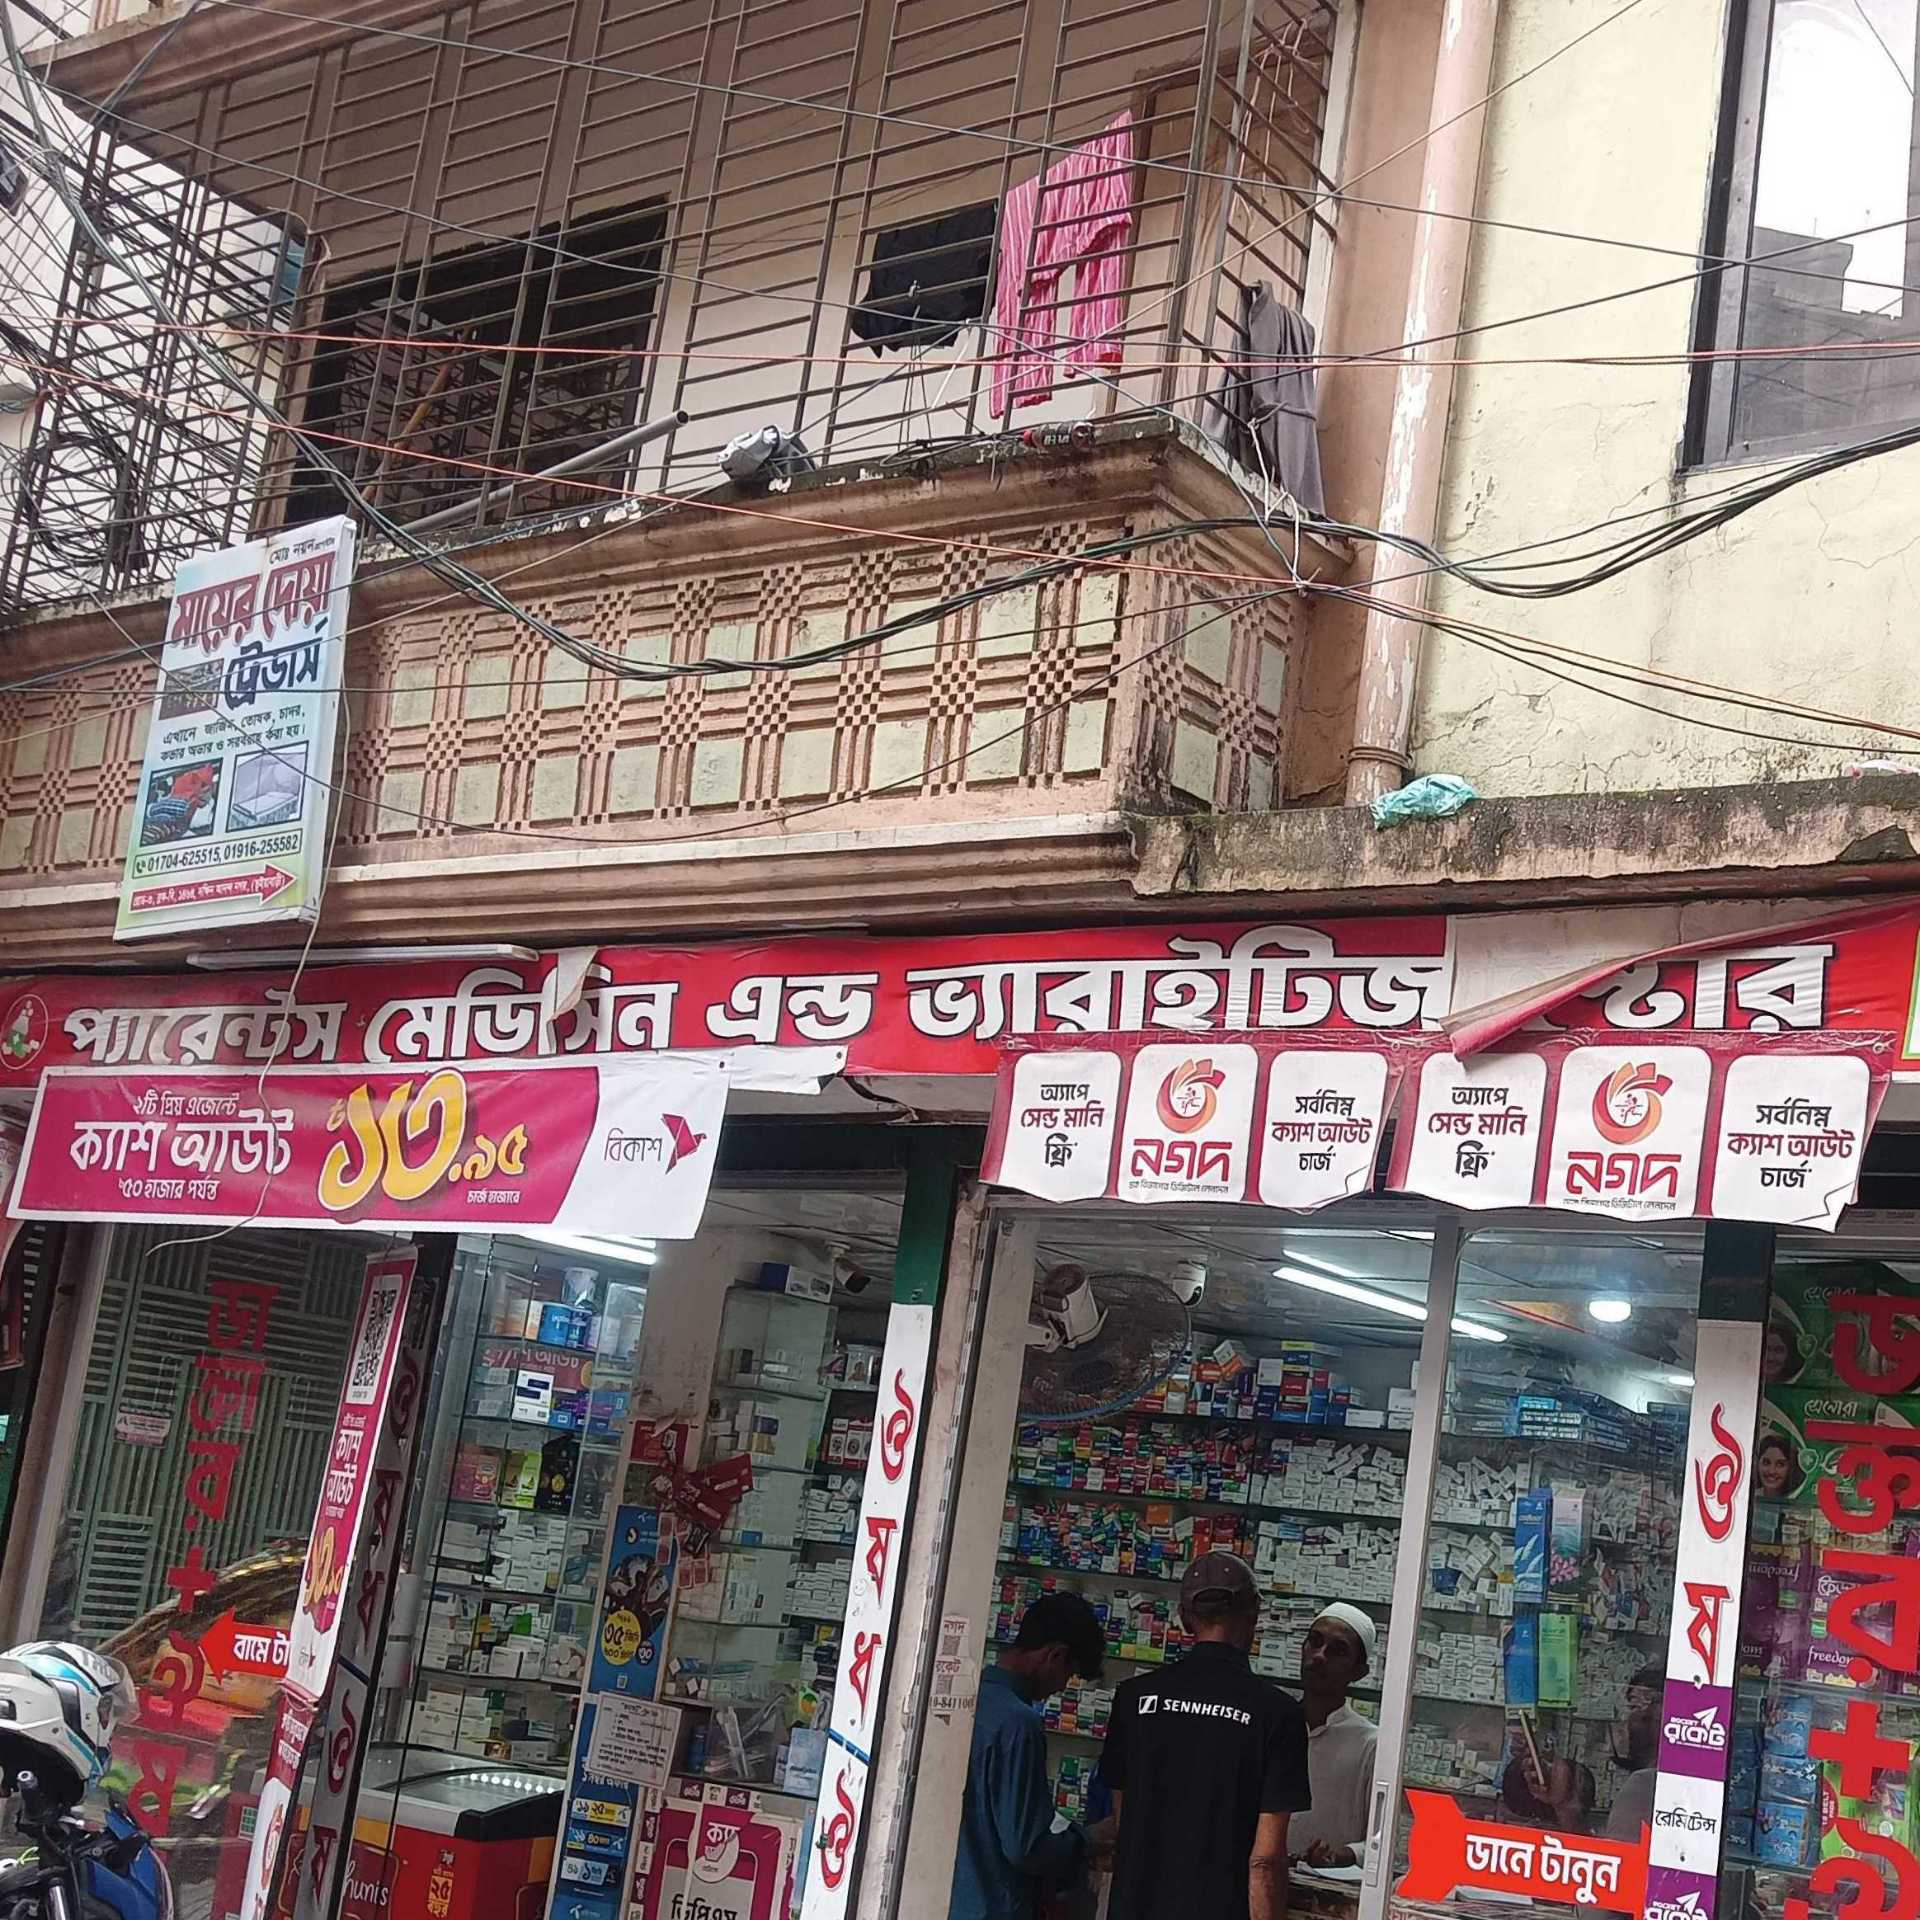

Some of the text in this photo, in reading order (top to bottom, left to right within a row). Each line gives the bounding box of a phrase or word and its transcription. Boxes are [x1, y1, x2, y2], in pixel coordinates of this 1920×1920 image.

[171, 551, 336, 656] মায়ের দোয়া
[225, 617, 328, 711] ট্রেডার্স
[223, 834, 298, 860] 01916-255582
[64, 988, 347, 1065] প্যারেন্টস
[705, 971, 880, 1044] এন্ড
[905, 924, 1449, 1041] ভ্যারাইটিজ
[132, 1089, 240, 1118] ২টি প্রিয় এজেন্টে
[1040, 1083, 1091, 1102] অ্যাপে
[1295, 1089, 1357, 1117] সর্বনিম্ন
[1451, 1086, 1509, 1107] অ্যাপে
[1021, 1100, 1105, 1129] সেন্ড মানি
[1428, 1103, 1529, 1137] সেন্ড মানি
[1756, 1097, 1831, 1127] সর্বনিম্ন
[69, 1108, 295, 1176] ক্যাশ আউট
[603, 1127, 662, 1164] বিকাশ
[1271, 1117, 1374, 1145] ক্যাশ আউট
[1727, 1127, 1857, 1159] ক্যাশ আউট
[1130, 1138, 1233, 1183] নগদ
[1299, 1145, 1332, 1172] চার্জ
[144, 1177, 186, 1200] হাজার
[187, 1174, 220, 1201] পর্যন্ত
[1566, 1150, 1682, 1197] নগদ
[1760, 1160, 1807, 1189] চার্জ
[233, 1633, 268, 1664] বামে
[1807, 1645, 1853, 1666] freedo
[1163, 1698, 1251, 1725] SENNHEISER
[1664, 1720, 1727, 1749] রকেট
[1464, 1834, 1623, 1904] ডানে টানুন
